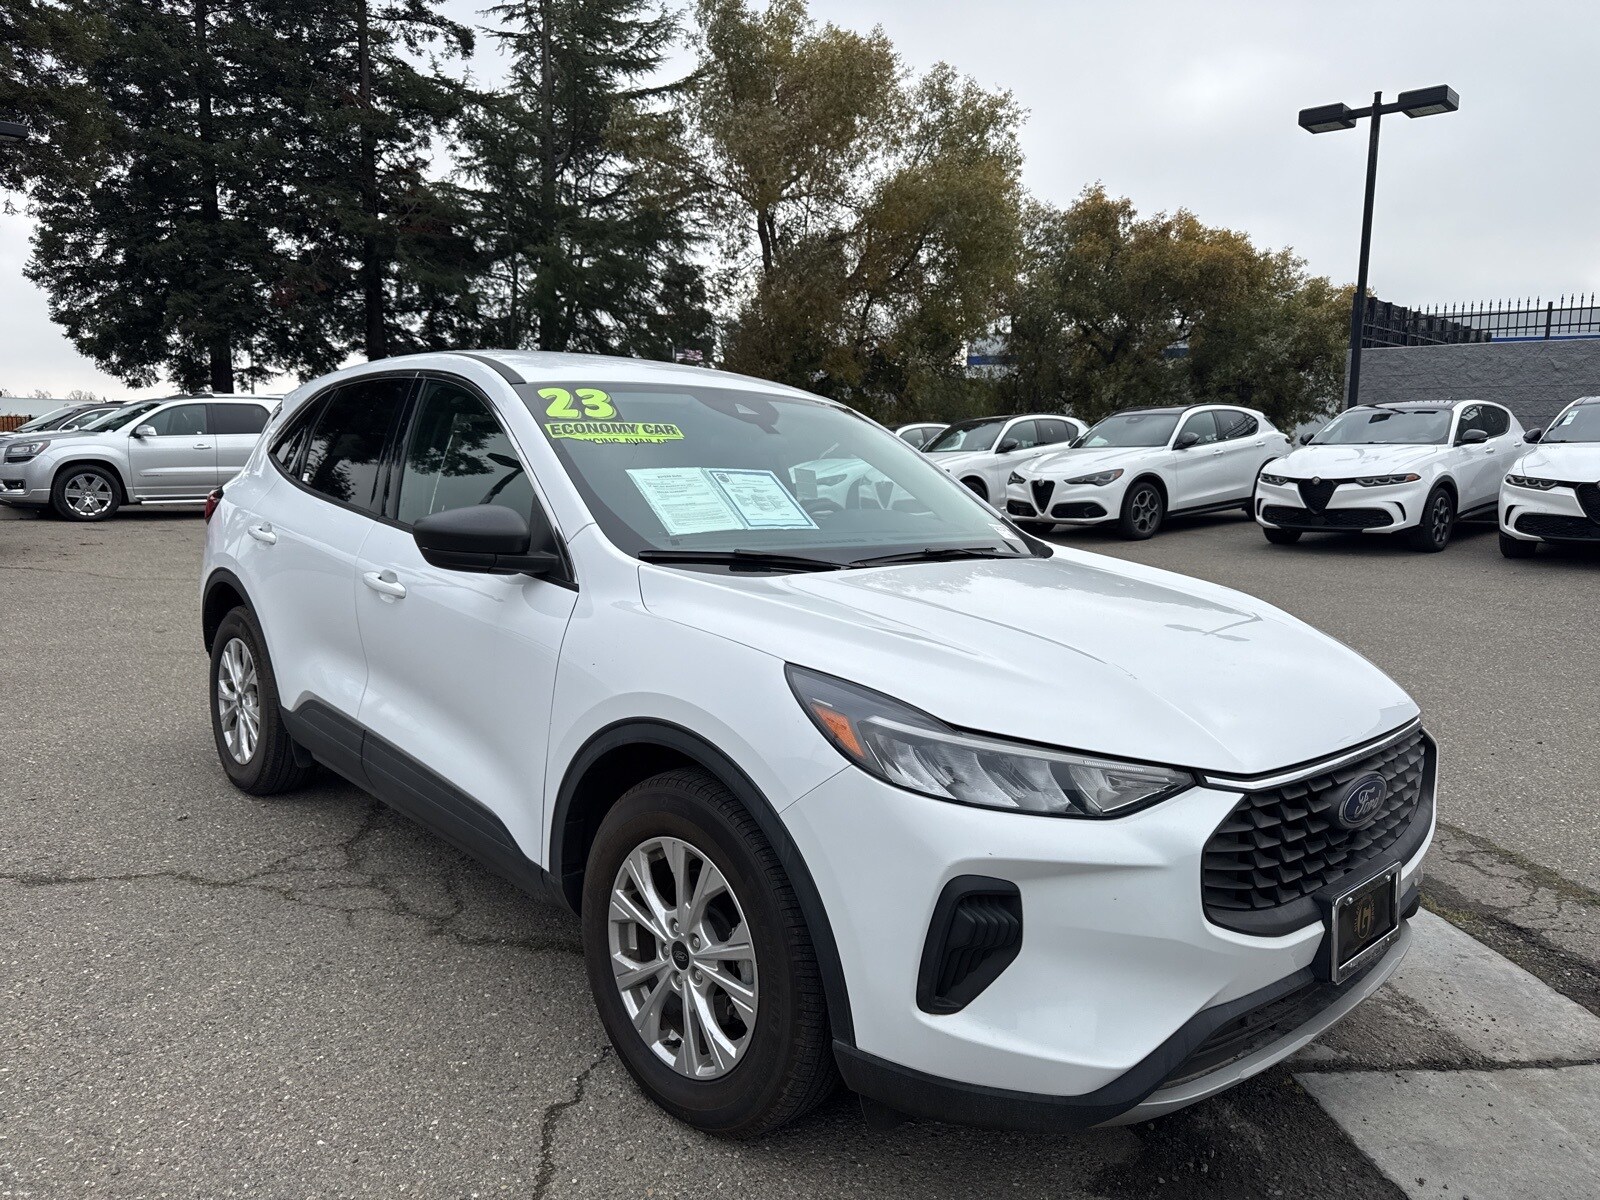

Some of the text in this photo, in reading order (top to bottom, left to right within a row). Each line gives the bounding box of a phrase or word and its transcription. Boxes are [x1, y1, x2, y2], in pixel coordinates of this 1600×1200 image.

[537, 387, 617, 419] 23
[550, 423, 678, 435] ECONOMY CAR
[1354, 786, 1381, 818] Ford
